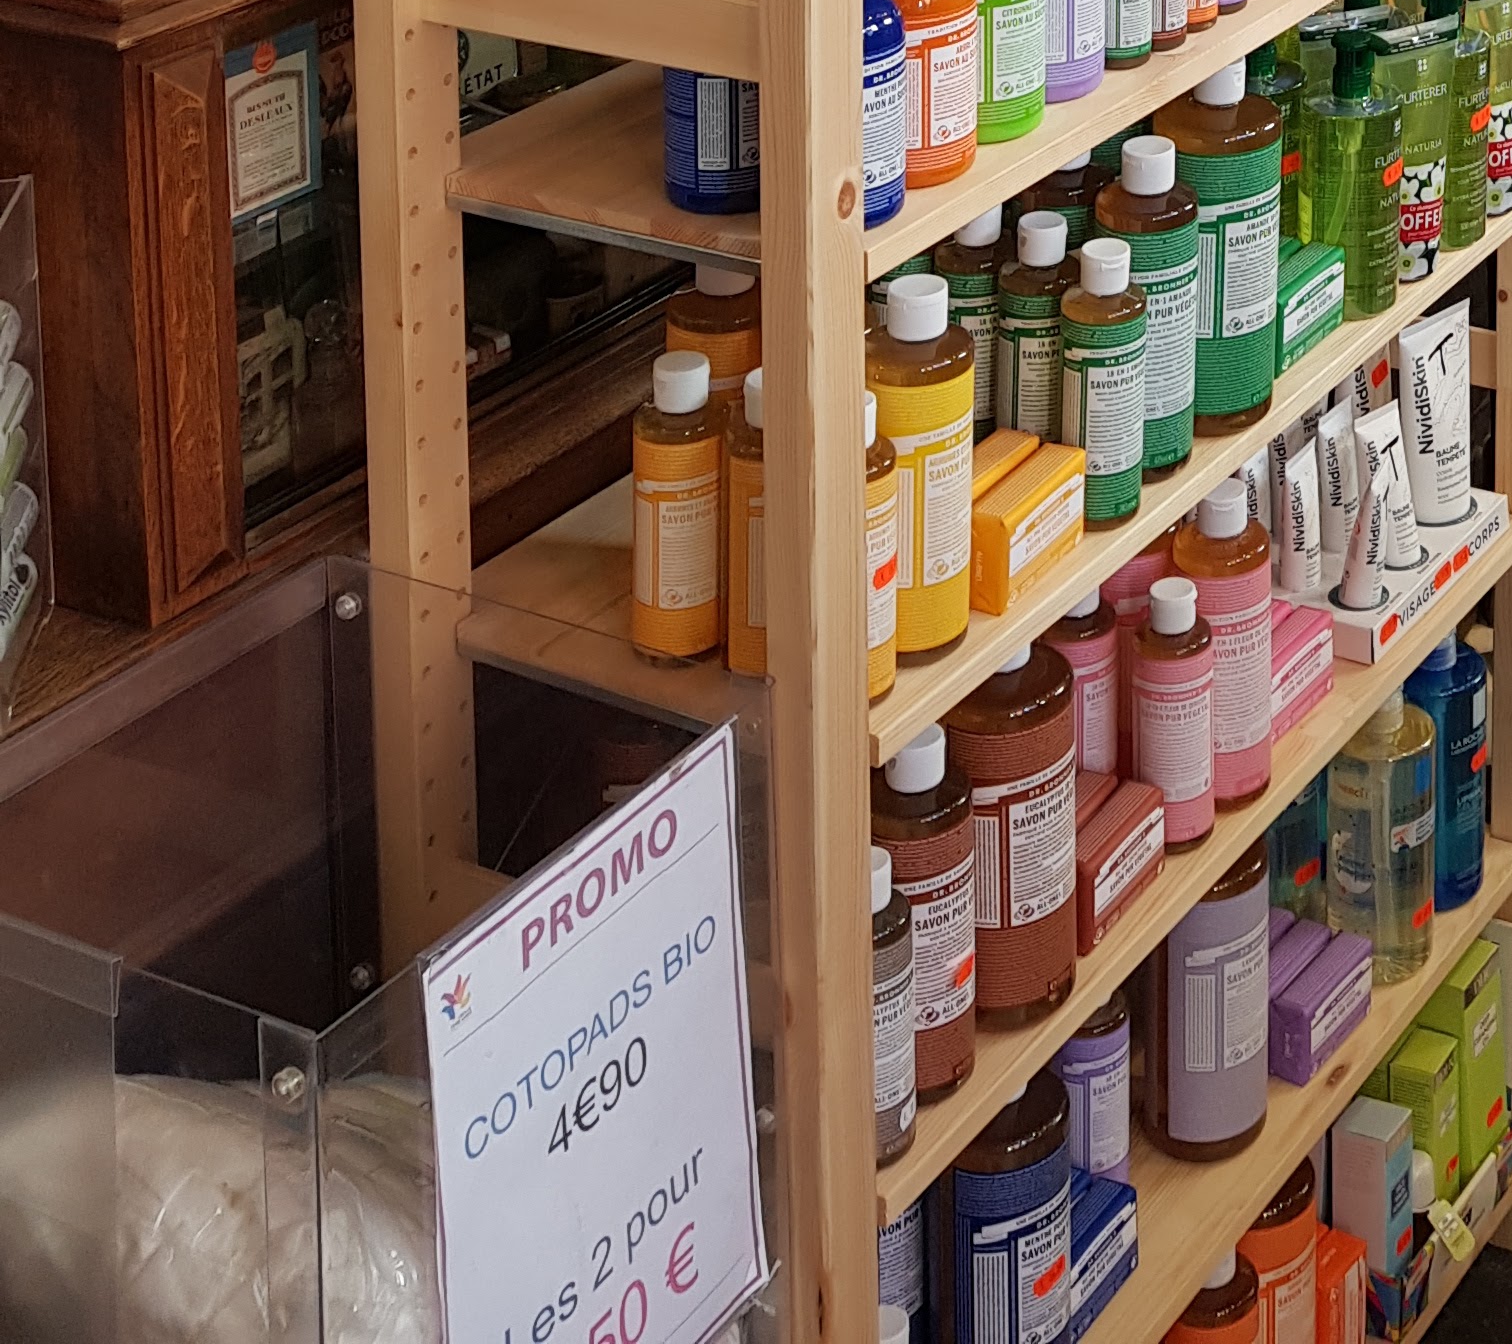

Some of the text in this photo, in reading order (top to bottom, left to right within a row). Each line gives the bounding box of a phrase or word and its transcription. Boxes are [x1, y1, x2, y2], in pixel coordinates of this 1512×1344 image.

[996, 16, 1023, 30] SAVON
[934, 57, 960, 72] SAVON
[864, 100, 886, 113] AVON
[1404, 138, 1442, 154] NATURIA
[1401, 211, 1443, 231] OFFE
[1228, 232, 1257, 248] SAVON
[1022, 349, 1050, 361] SAVON
[1090, 378, 1119, 390] SAVON
[928, 464, 959, 482] SAVON
[1467, 515, 1501, 558] CORPS
[1398, 581, 1437, 628] VISAGE
[1012, 810, 1046, 831] SAVON
[519, 807, 681, 973] PROMO
[914, 911, 950, 931] SAVON
[1226, 964, 1252, 986] SAVON
[462, 914, 718, 1161] COTOPADS BIO
[546, 1035, 649, 1158] 4€90
[590, 1146, 705, 1293] 2 pour
[664, 1220, 701, 1297] €
[1021, 1242, 1052, 1261] SAVON
